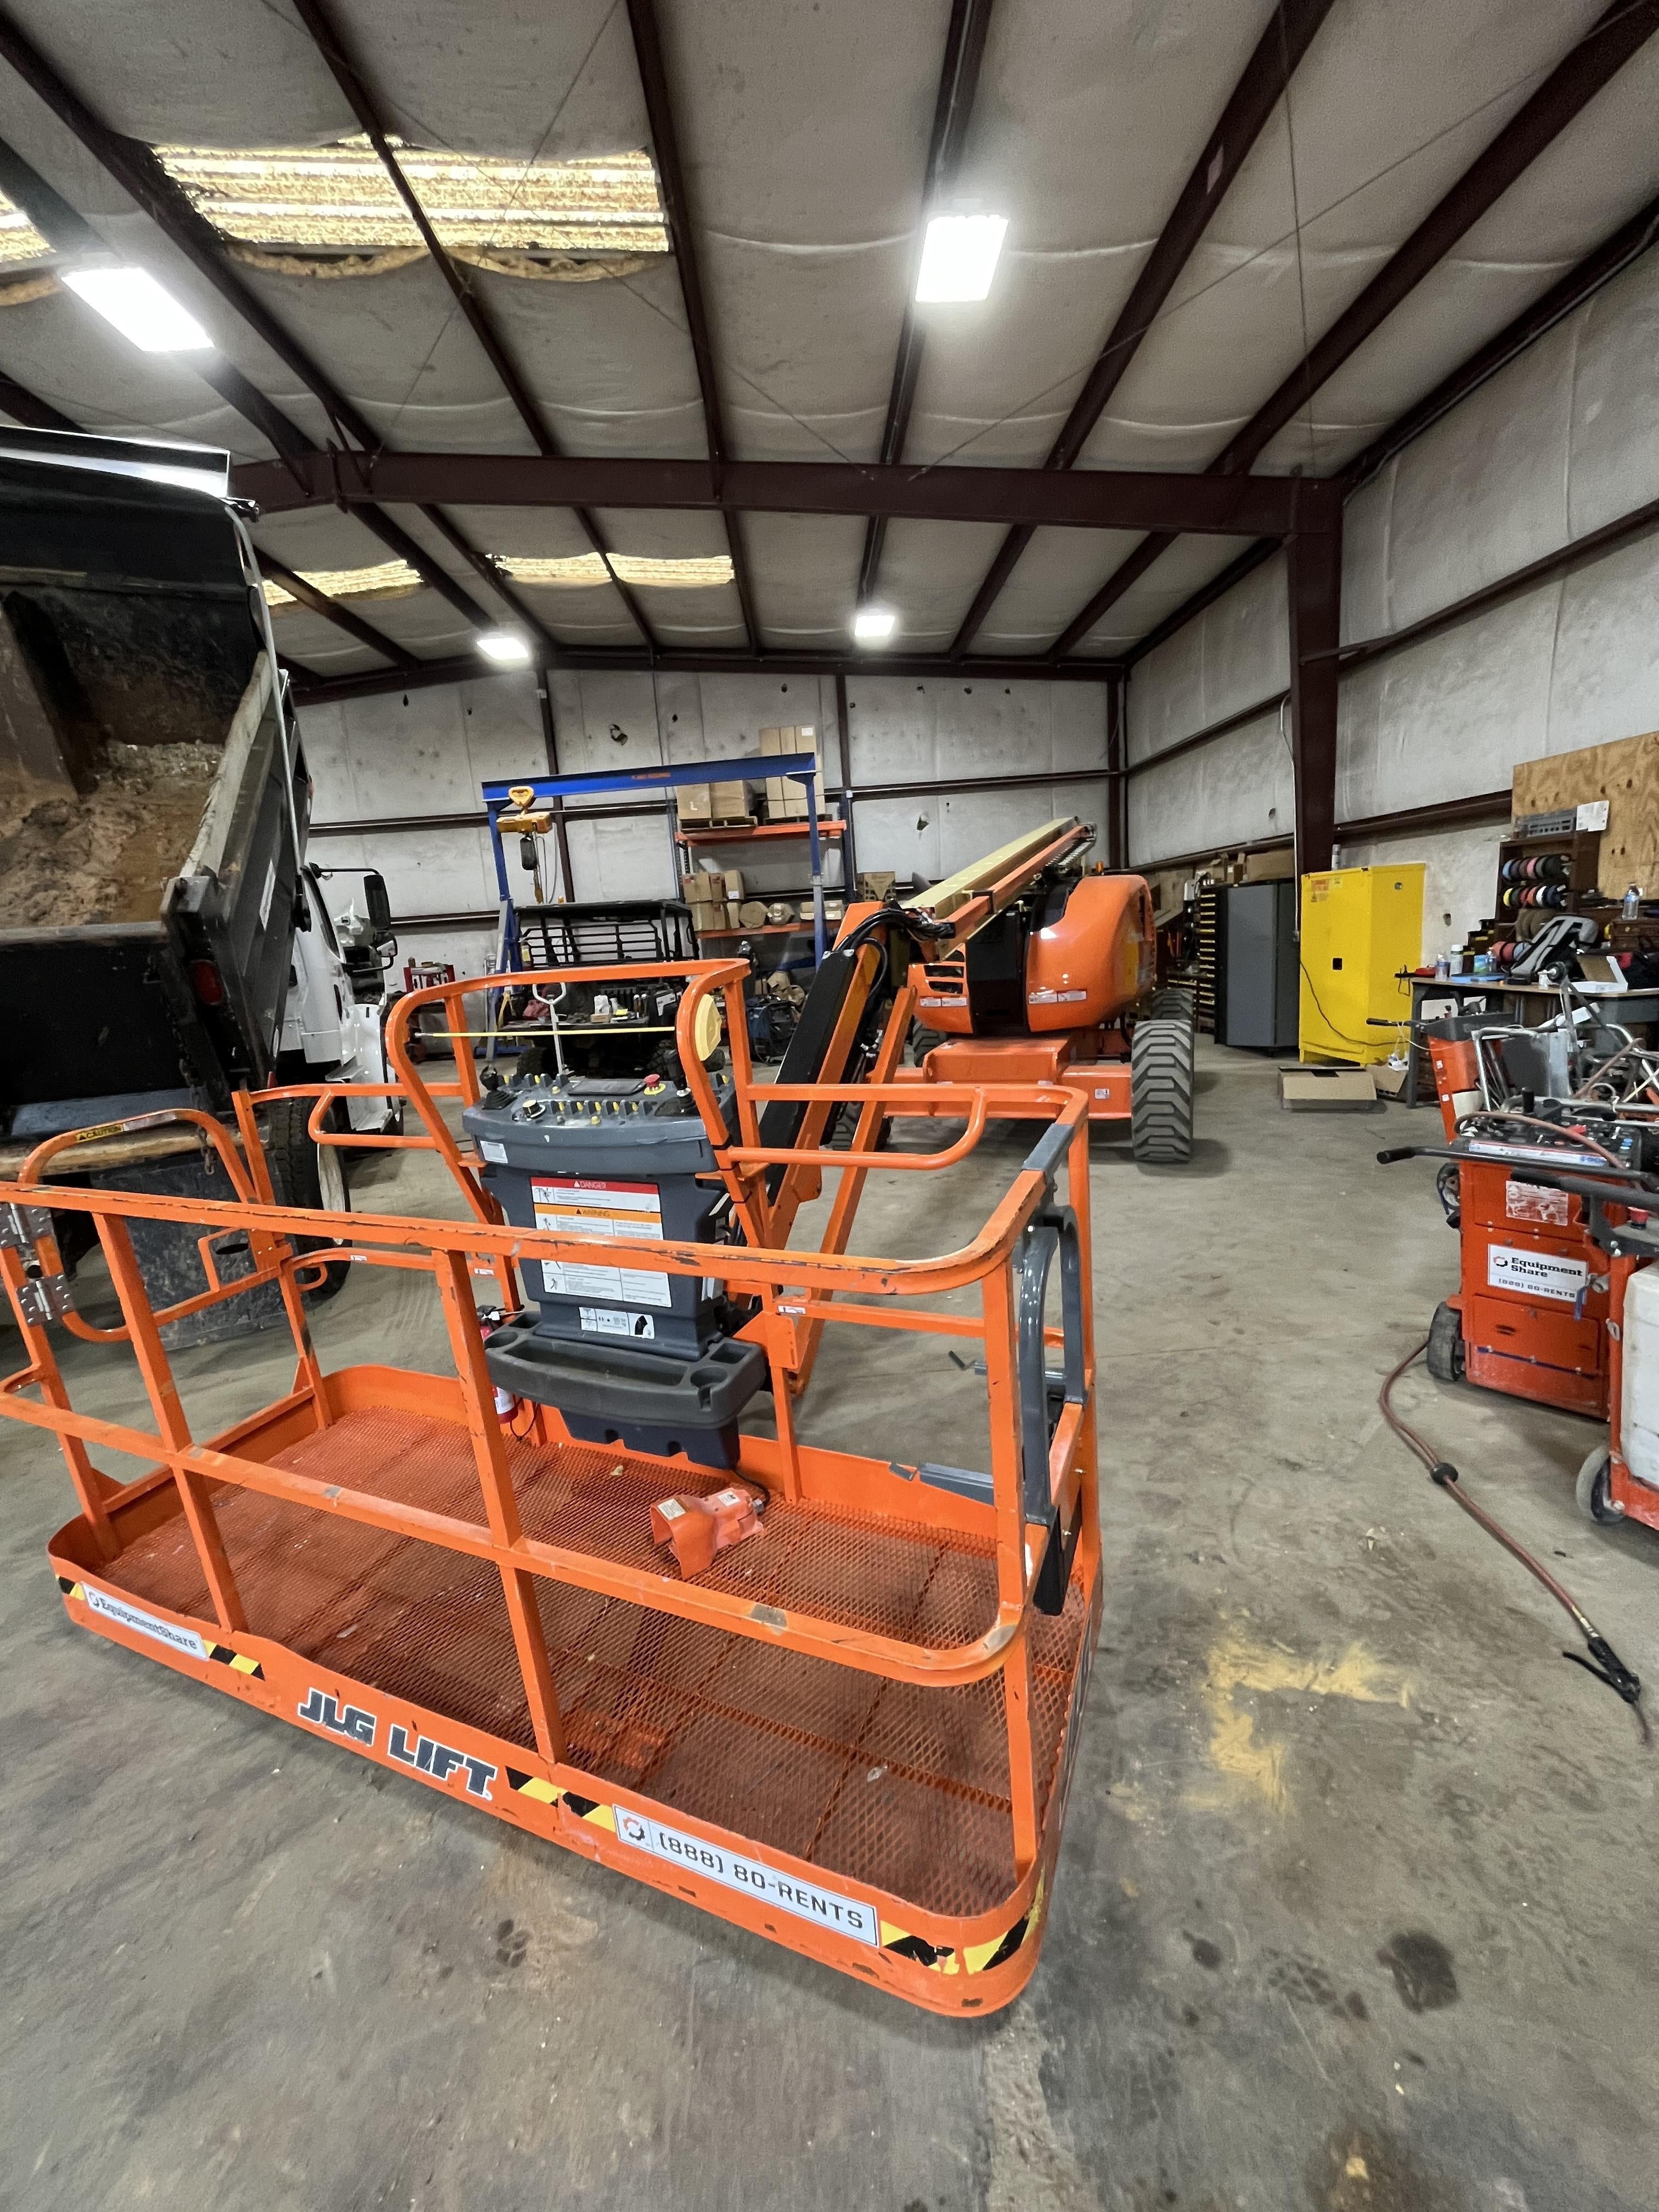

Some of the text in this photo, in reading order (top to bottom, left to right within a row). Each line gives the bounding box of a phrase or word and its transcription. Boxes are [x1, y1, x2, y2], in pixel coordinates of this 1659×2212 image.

[86, 1126, 121, 1139] CAUTION
[1511, 1257, 1584, 1277] Equipment
[1511, 1265, 1548, 1278] Share
[1498, 1278, 1576, 1298] (888) 80-RENTS
[99, 1596, 198, 1650] EquipmentShare
[297, 1687, 499, 1798] JLG LIFT
[658, 1832, 863, 1929] (888) 80-RENTS
